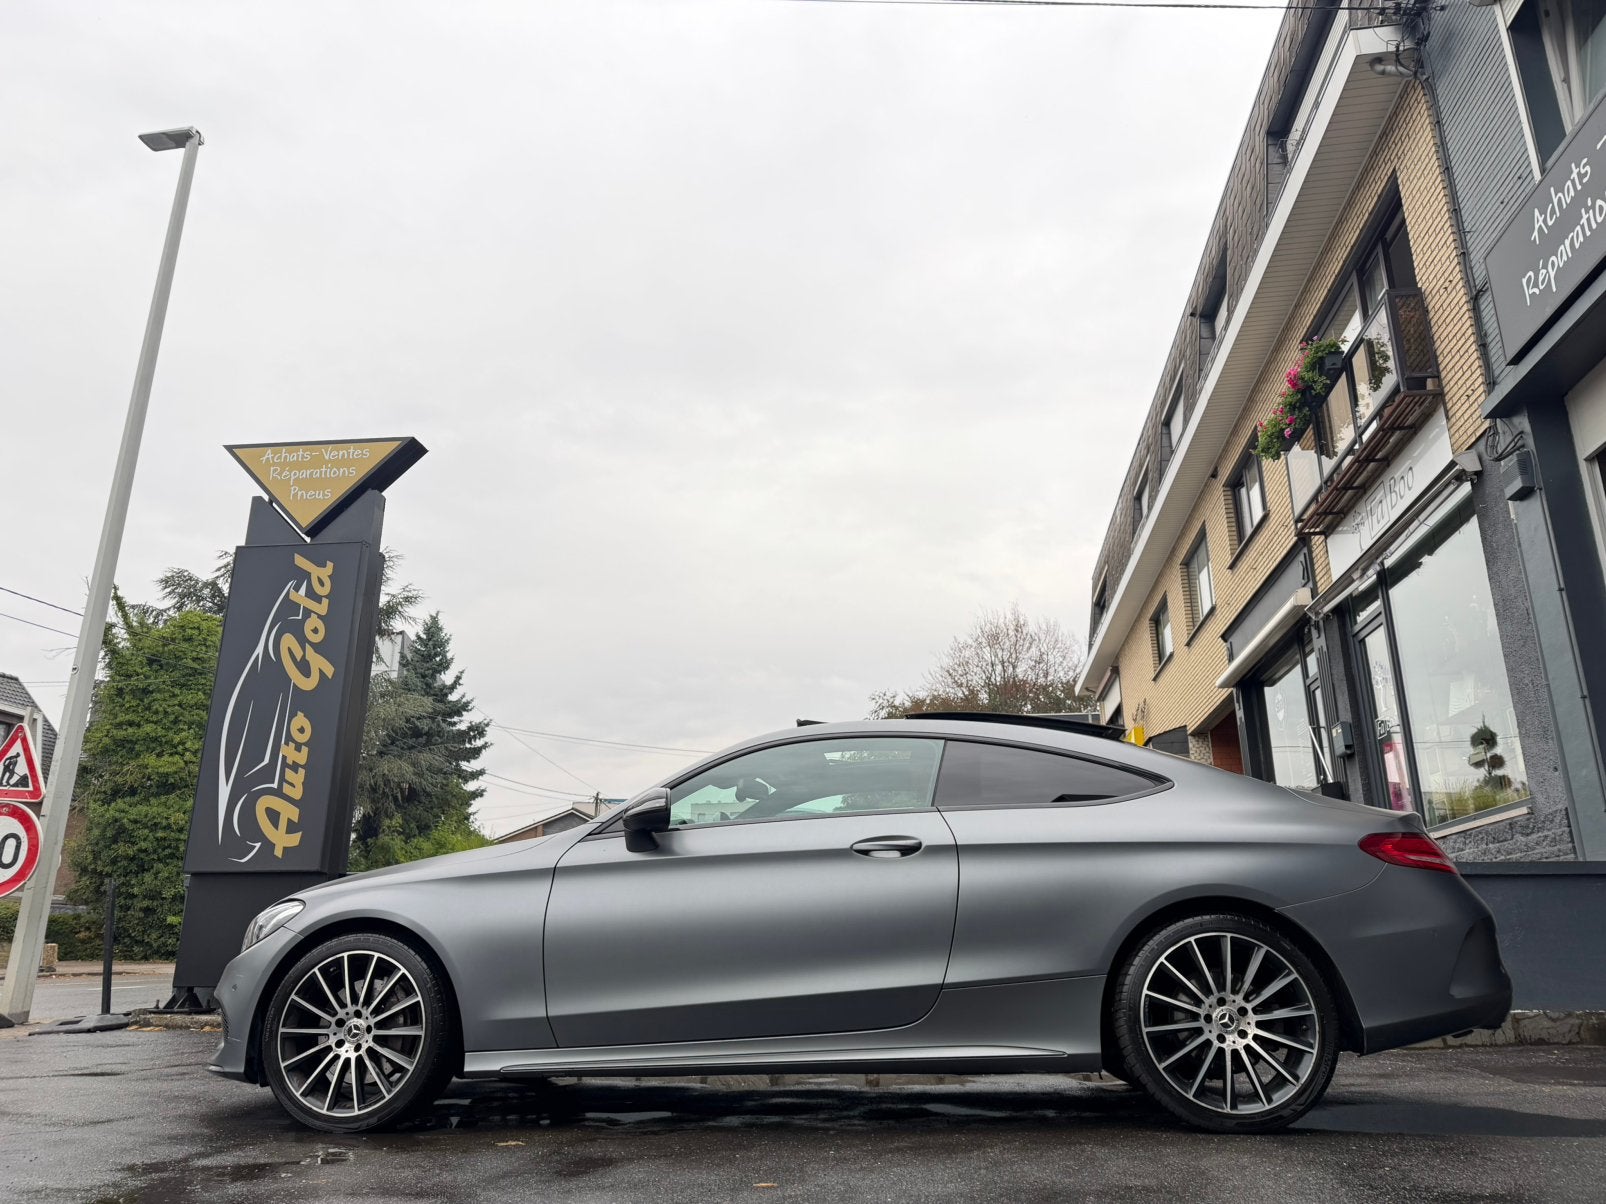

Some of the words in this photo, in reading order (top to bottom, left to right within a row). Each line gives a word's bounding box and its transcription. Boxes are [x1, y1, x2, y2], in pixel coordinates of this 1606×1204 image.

[1521, 190, 1606, 306] Réparatio
[1531, 157, 1592, 245] Achats
[269, 464, 356, 485] Réparations
[290, 486, 332, 501] Pneus
[279, 553, 335, 692] Gold
[255, 711, 312, 859] Auto
